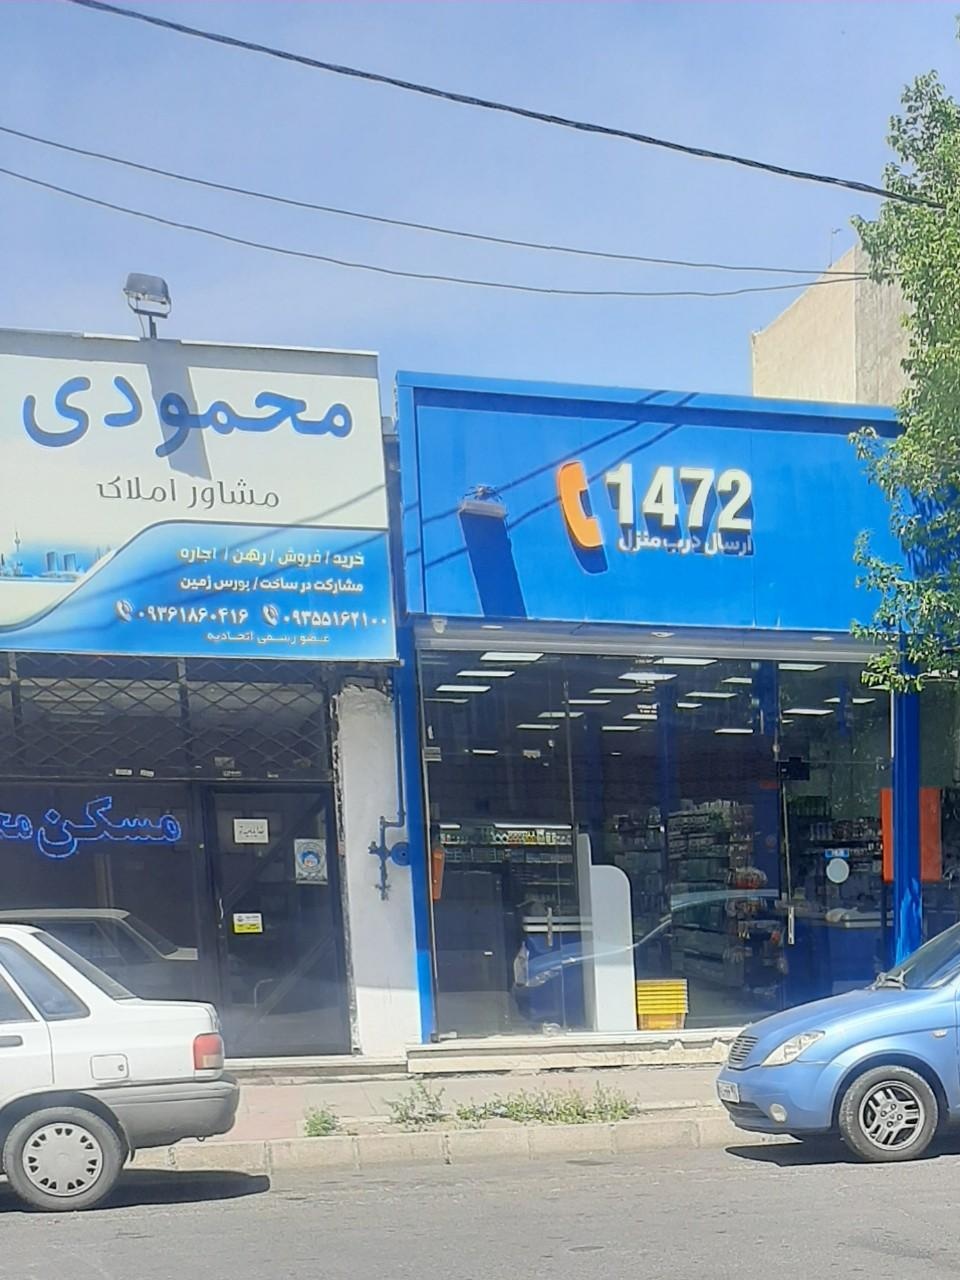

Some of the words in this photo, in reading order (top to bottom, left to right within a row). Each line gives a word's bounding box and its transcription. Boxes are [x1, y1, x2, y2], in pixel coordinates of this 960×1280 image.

[22, 375, 353, 458] محمودی
[96, 475, 177, 503] املاک
[187, 478, 280, 510] مشاور
[605, 463, 753, 531] 1472
[618, 528, 662, 552] منزل
[662, 534, 702, 554] درب
[704, 531, 752, 556] ارسال
[179, 546, 217, 564] اجاره
[232, 549, 267, 566] رهن
[278, 548, 321, 567] فروش
[332, 551, 365, 569] خرید
[180, 575, 212, 590] زمین
[213, 578, 250, 592] بورس
[299, 580, 312, 593] در
[313, 577, 364, 594] مشارکت
[206, 631, 254, 643] اتحادیه
[257, 631, 297, 645] رسمی
[299, 632, 330, 645] عضو
[37, 796, 182, 858] مسکن
